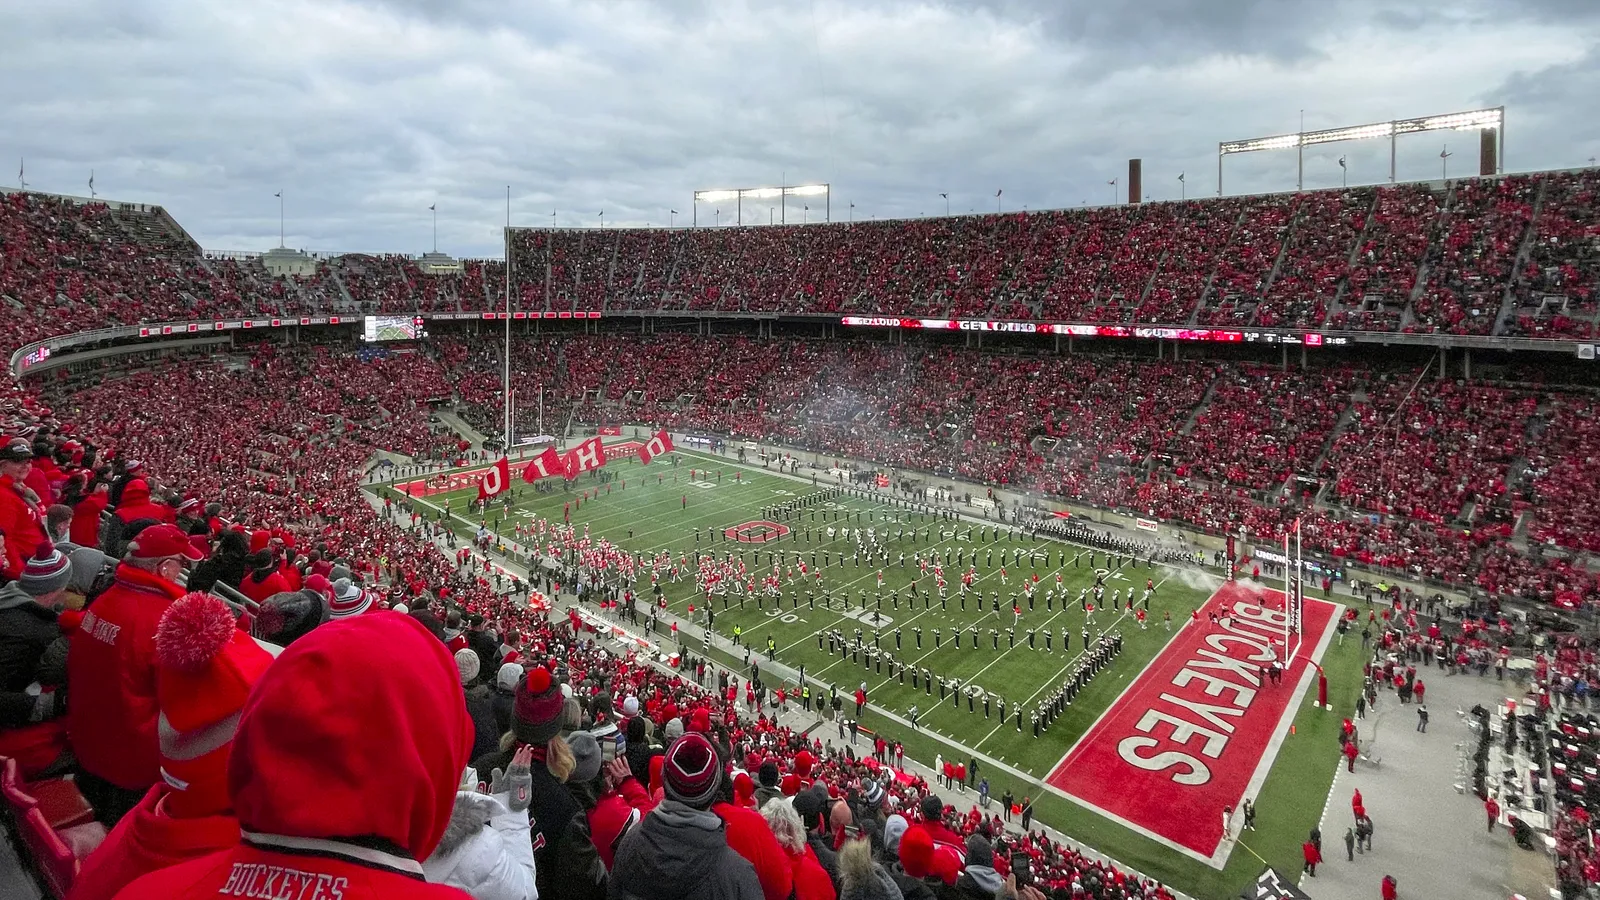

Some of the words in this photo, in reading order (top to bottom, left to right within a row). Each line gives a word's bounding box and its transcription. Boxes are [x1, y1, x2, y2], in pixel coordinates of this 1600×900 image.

[873, 318, 901, 327] LOUD
[1326, 337, 1347, 345] 3:05
[576, 440, 600, 471] H
[646, 437, 666, 458] O
[533, 458, 551, 478] I
[483, 465, 502, 496] O
[1255, 549, 1285, 563] UNION
[92, 617, 122, 646] STATE
[459, 634, 466, 644] 7
[1117, 601, 1290, 786] BUCKEYES
[218, 862, 350, 900] BUCKEYES
